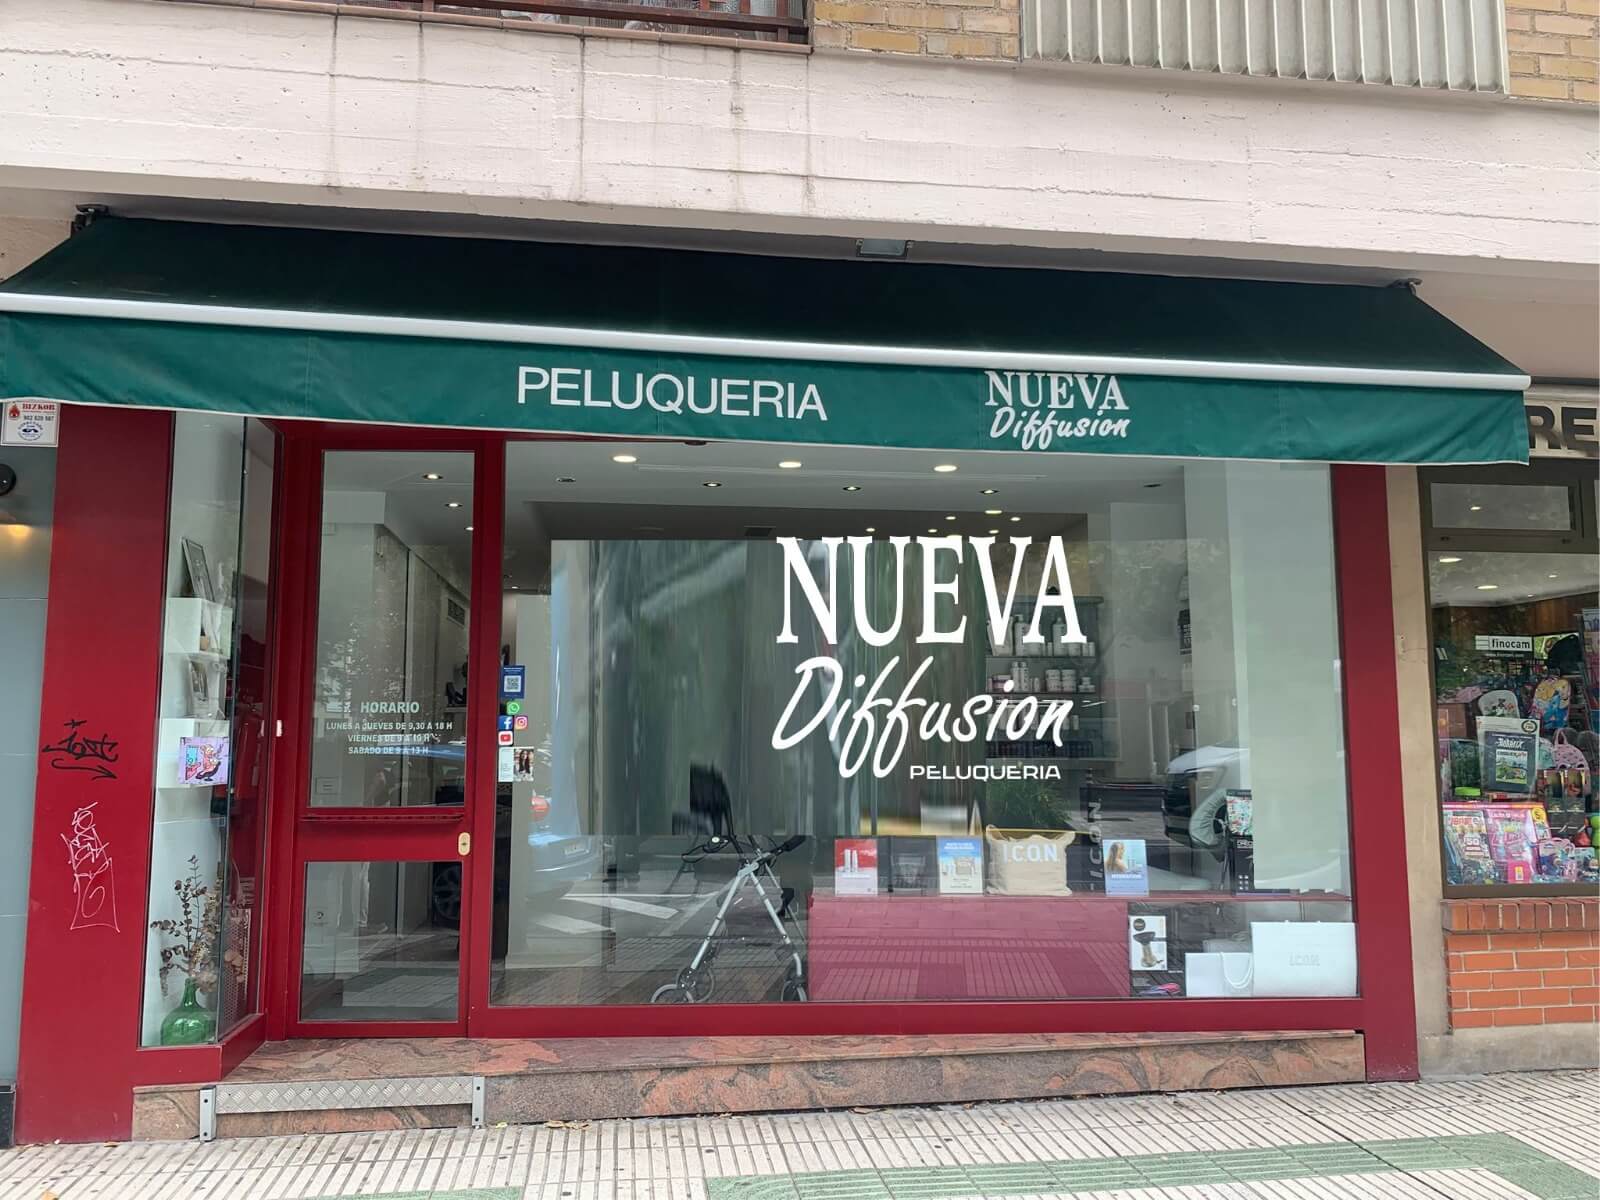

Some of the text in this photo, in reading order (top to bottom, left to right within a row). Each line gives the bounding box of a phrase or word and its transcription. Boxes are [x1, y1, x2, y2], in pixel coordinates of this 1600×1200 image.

[517, 365, 828, 421] PELUQUERIA
[984, 370, 1130, 411] NUEVA
[989, 406, 1131, 451] Diffusion
[776, 535, 1088, 647] NUEVA
[1491, 638, 1531, 649] finocam
[359, 701, 420, 714] HORARIO
[771, 655, 1074, 779] Diffusion
[326, 722, 352, 730] LUNES
[354, 722, 361, 730] A
[362, 721, 394, 730] JUEVES
[395, 722, 407, 730] DE
[408, 722, 425, 731] 9,30
[426, 722, 433, 730] A
[446, 722, 453, 730] H
[383, 746, 395, 754] DE
[909, 765, 1062, 781] PELUQUERIA
